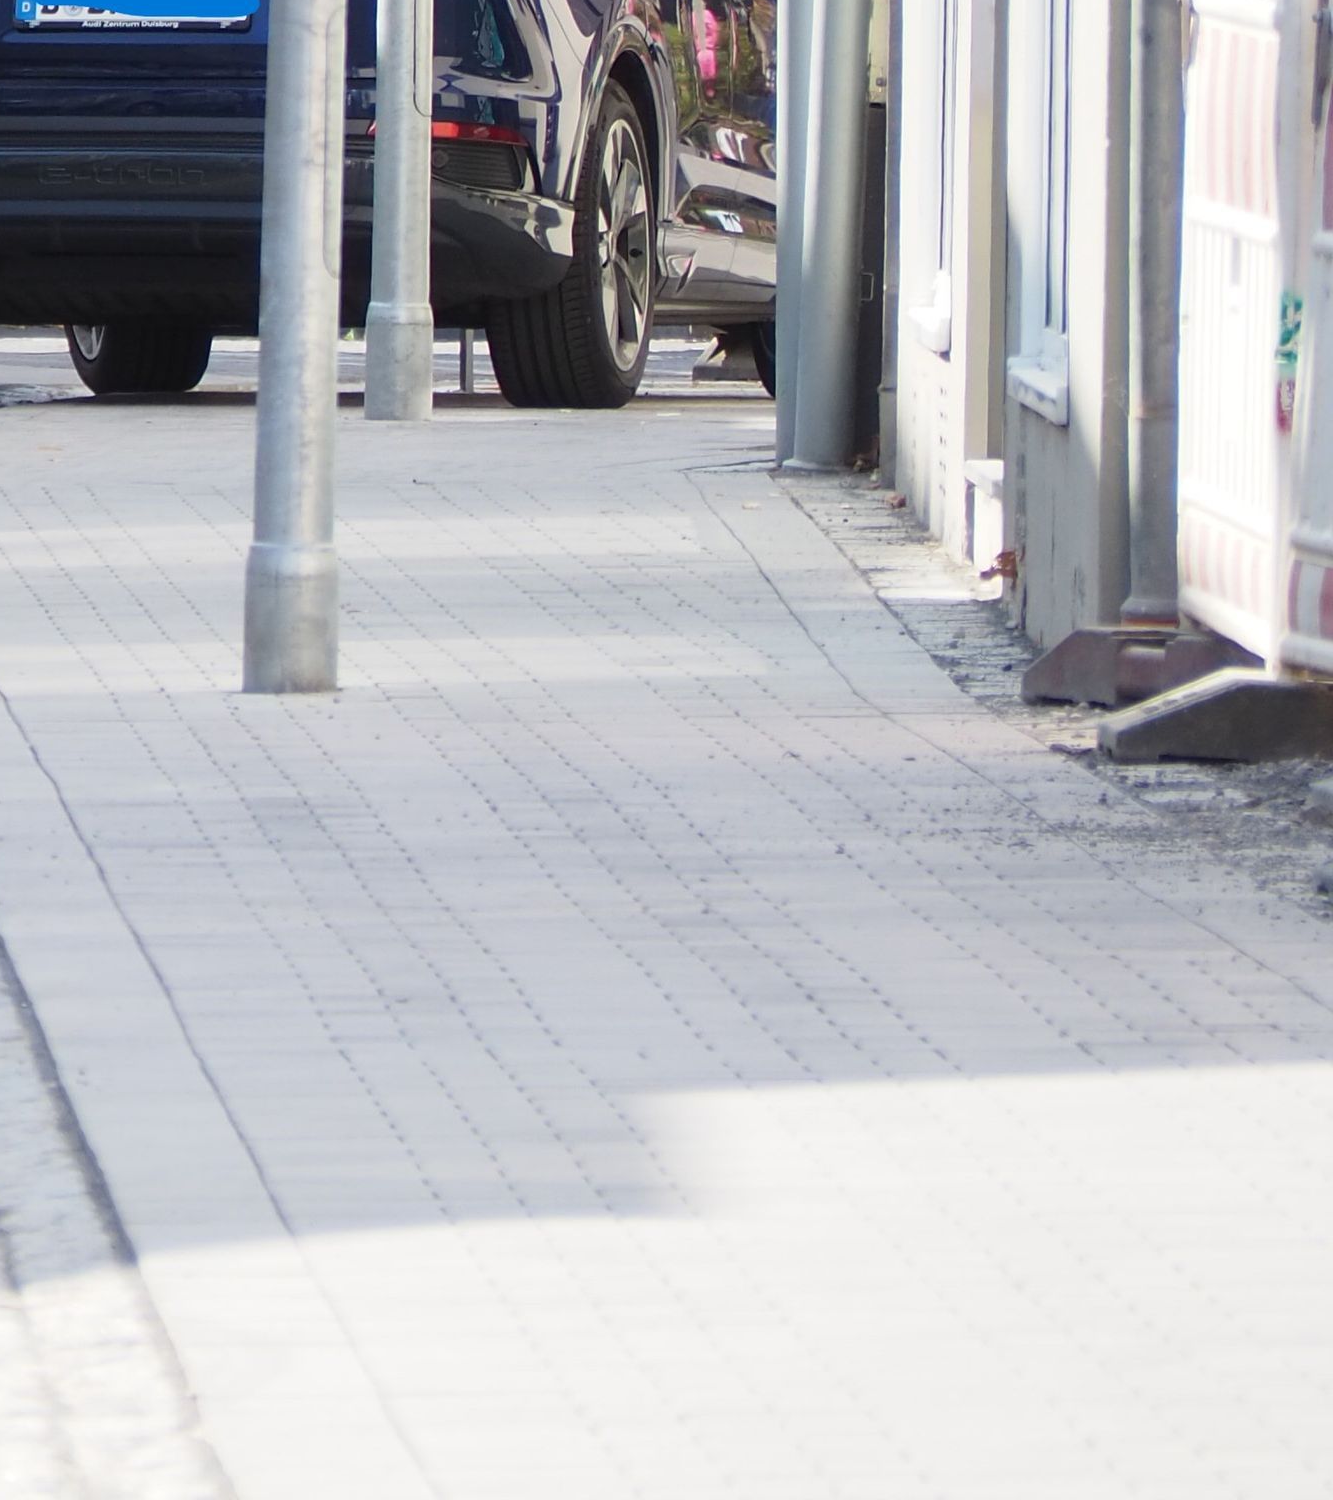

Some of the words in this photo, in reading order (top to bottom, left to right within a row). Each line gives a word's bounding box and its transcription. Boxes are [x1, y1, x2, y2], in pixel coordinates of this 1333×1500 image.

[21, 2, 31, 12] D
[81, 20, 102, 28] Audi
[102, 20, 140, 28] Zentrum
[141, 20, 179, 29] Duisburg
